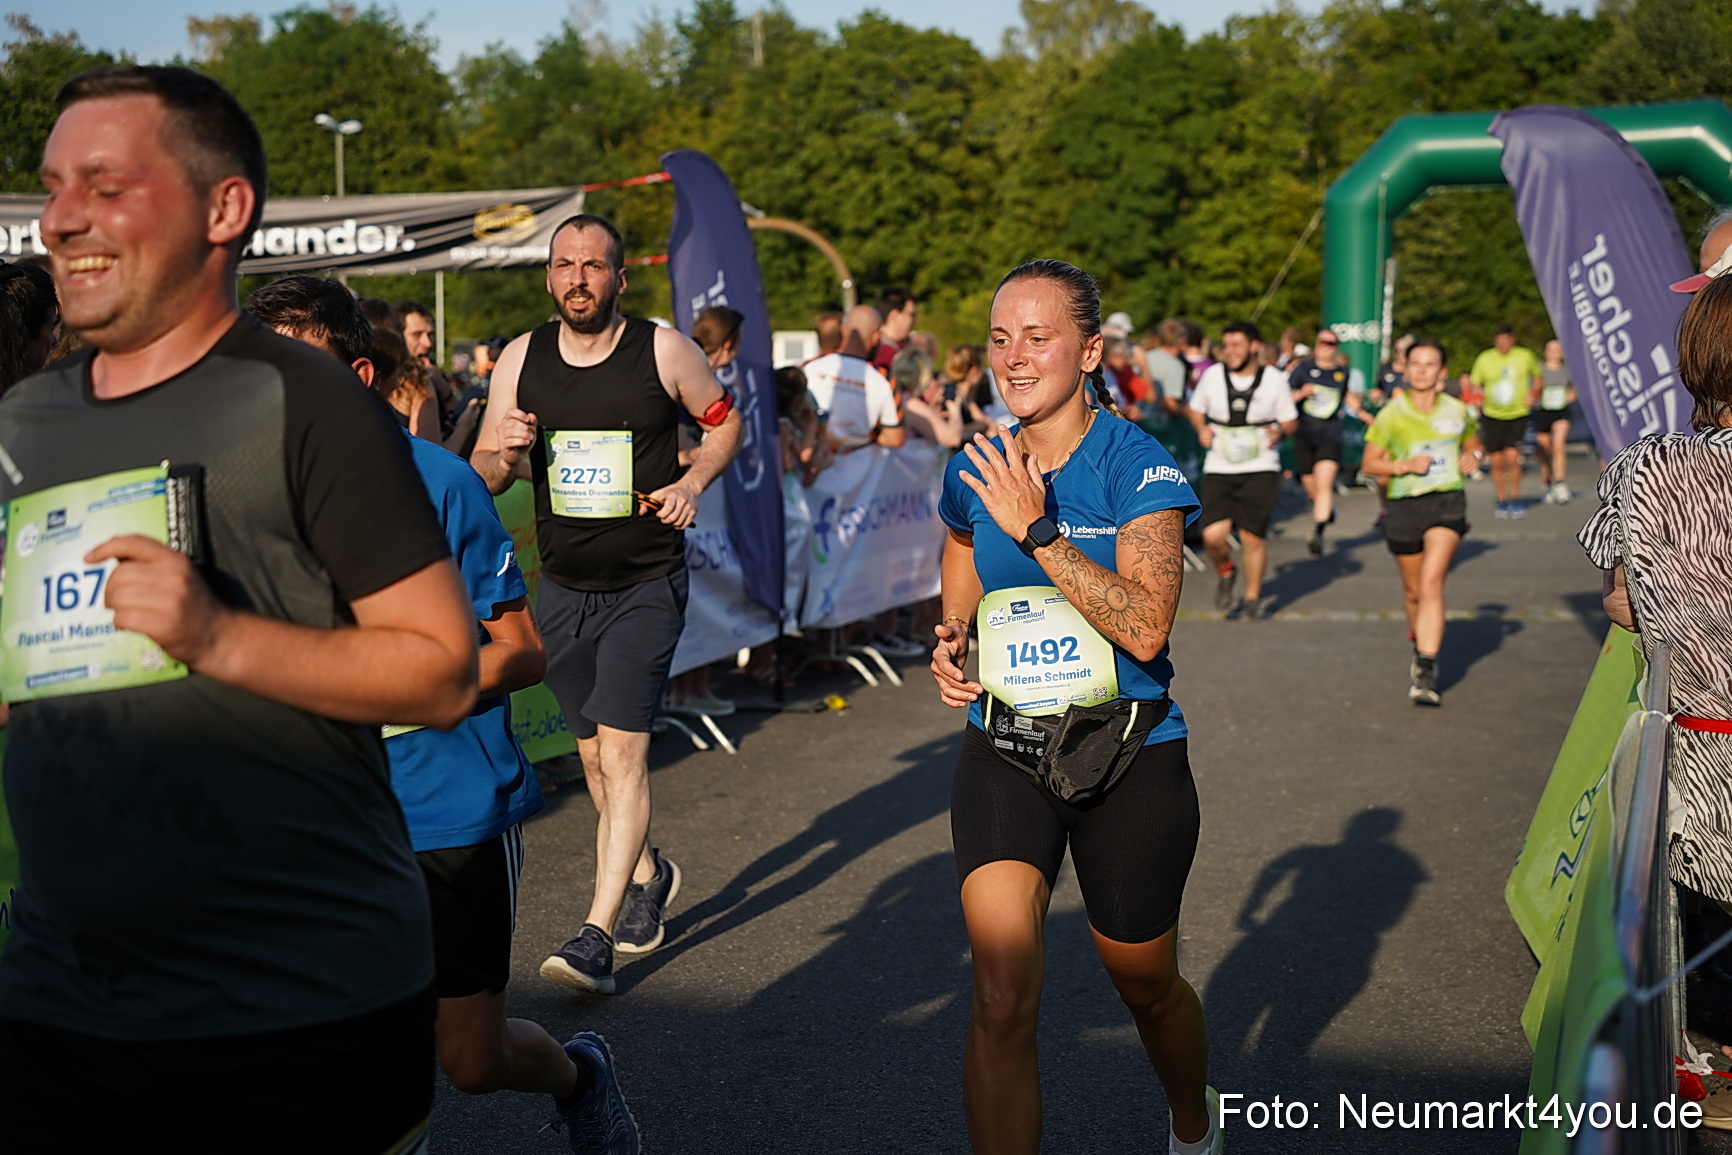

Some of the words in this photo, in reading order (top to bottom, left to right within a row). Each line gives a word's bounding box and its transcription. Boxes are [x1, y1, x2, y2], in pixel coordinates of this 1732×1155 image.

[560, 467, 611, 484] 2273
[1008, 609, 1045, 622] Firmenlauf
[1007, 636, 1081, 668] 1492
[1004, 674, 1042, 686] Milena
[1044, 668, 1092, 682] Schmidt
[1009, 727, 1045, 738] Firmenlauf
